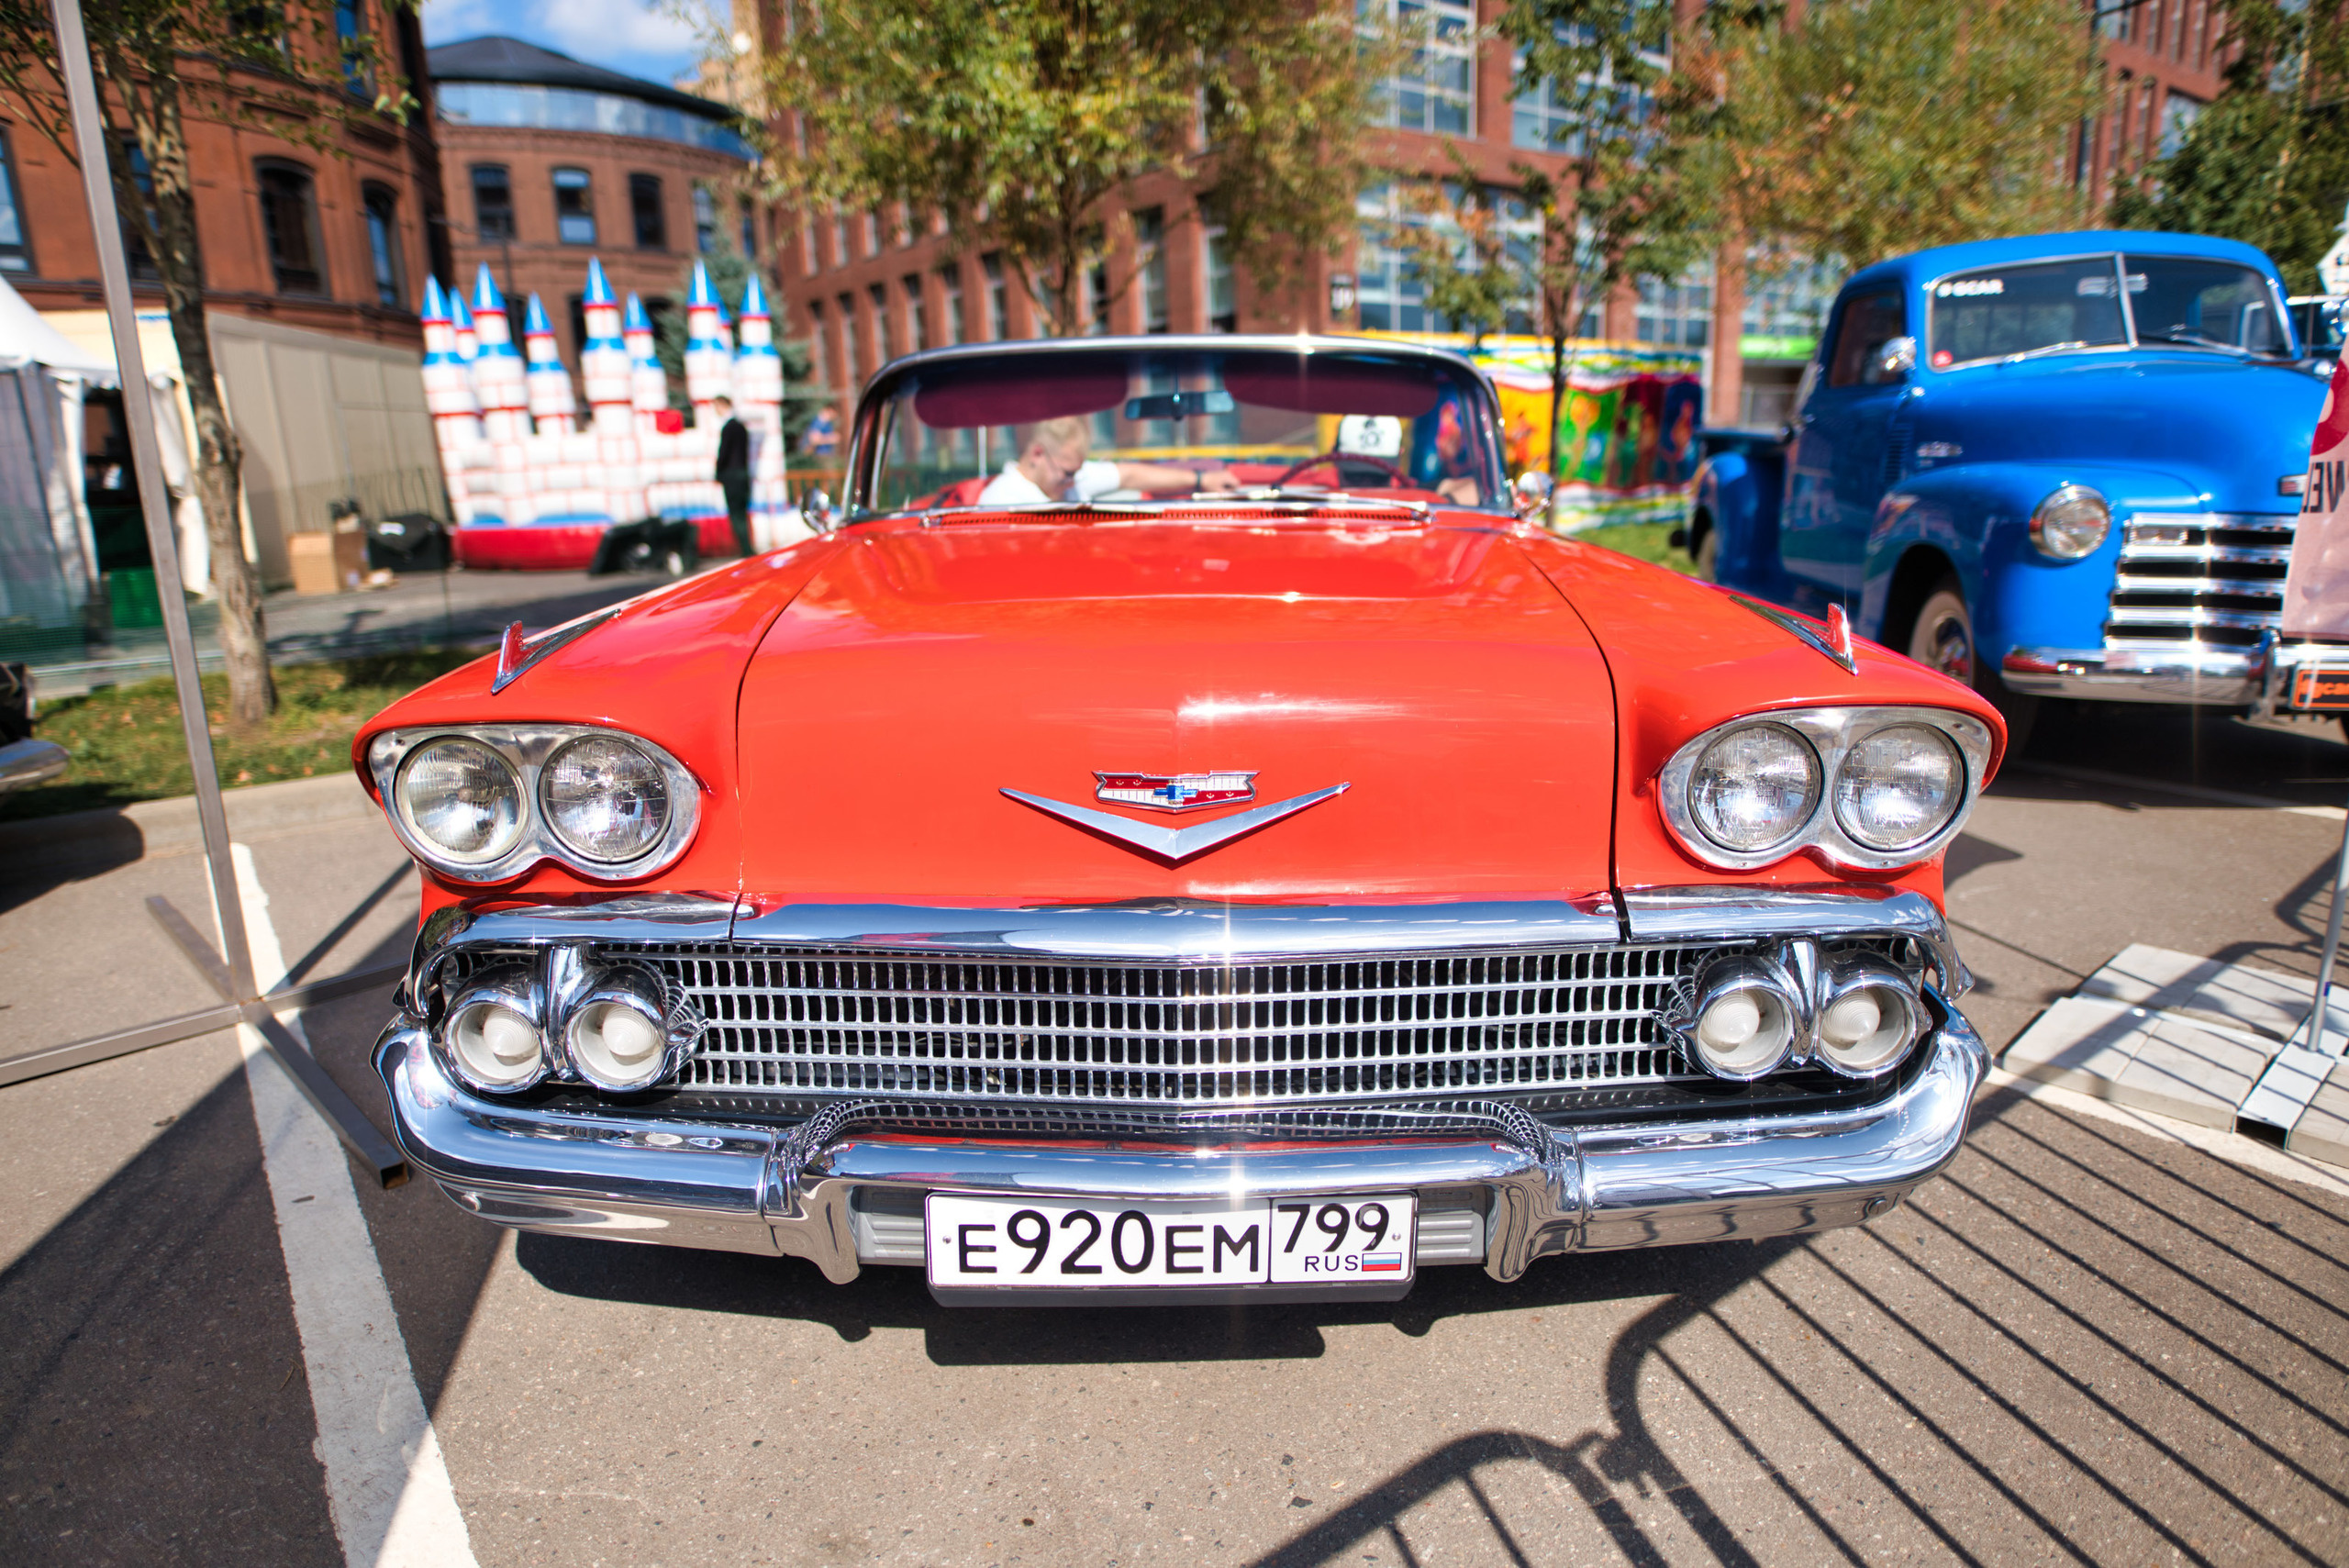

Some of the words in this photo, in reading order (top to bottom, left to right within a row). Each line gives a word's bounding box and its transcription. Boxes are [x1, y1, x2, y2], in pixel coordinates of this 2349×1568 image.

[957, 1208, 1260, 1274] E920EM
[1276, 1202, 1391, 1253] 799
[1304, 1254, 1359, 1273] RUS
